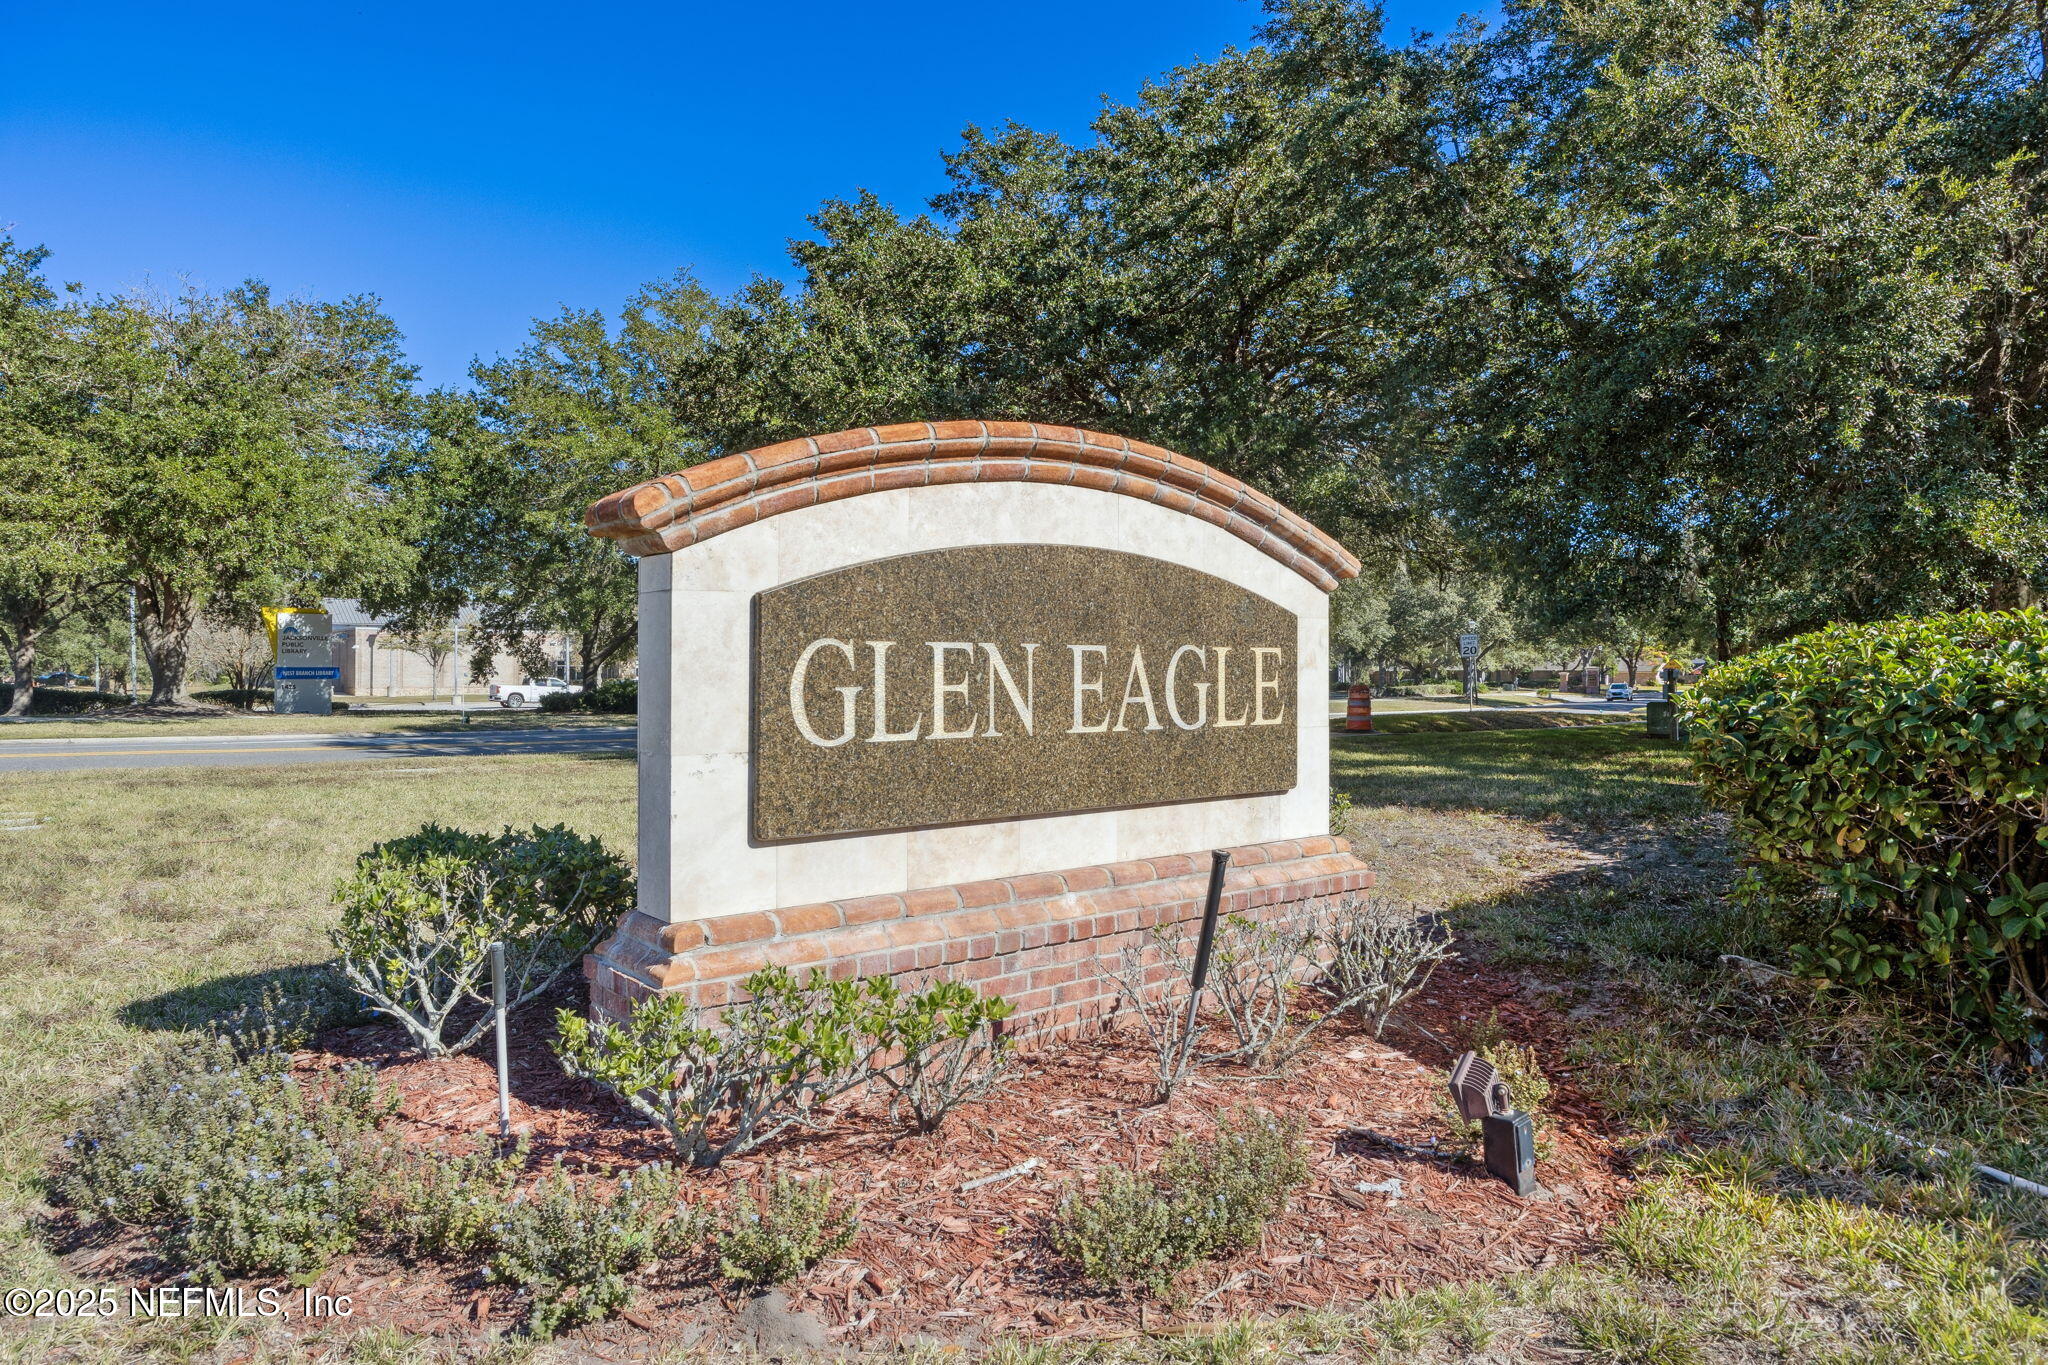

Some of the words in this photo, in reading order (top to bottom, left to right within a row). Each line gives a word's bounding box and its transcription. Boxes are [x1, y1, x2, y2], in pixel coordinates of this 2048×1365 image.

[1463, 646, 1477, 655] 20
[790, 636, 1040, 747] GLEN
[1066, 643, 1285, 733] EAGLE
